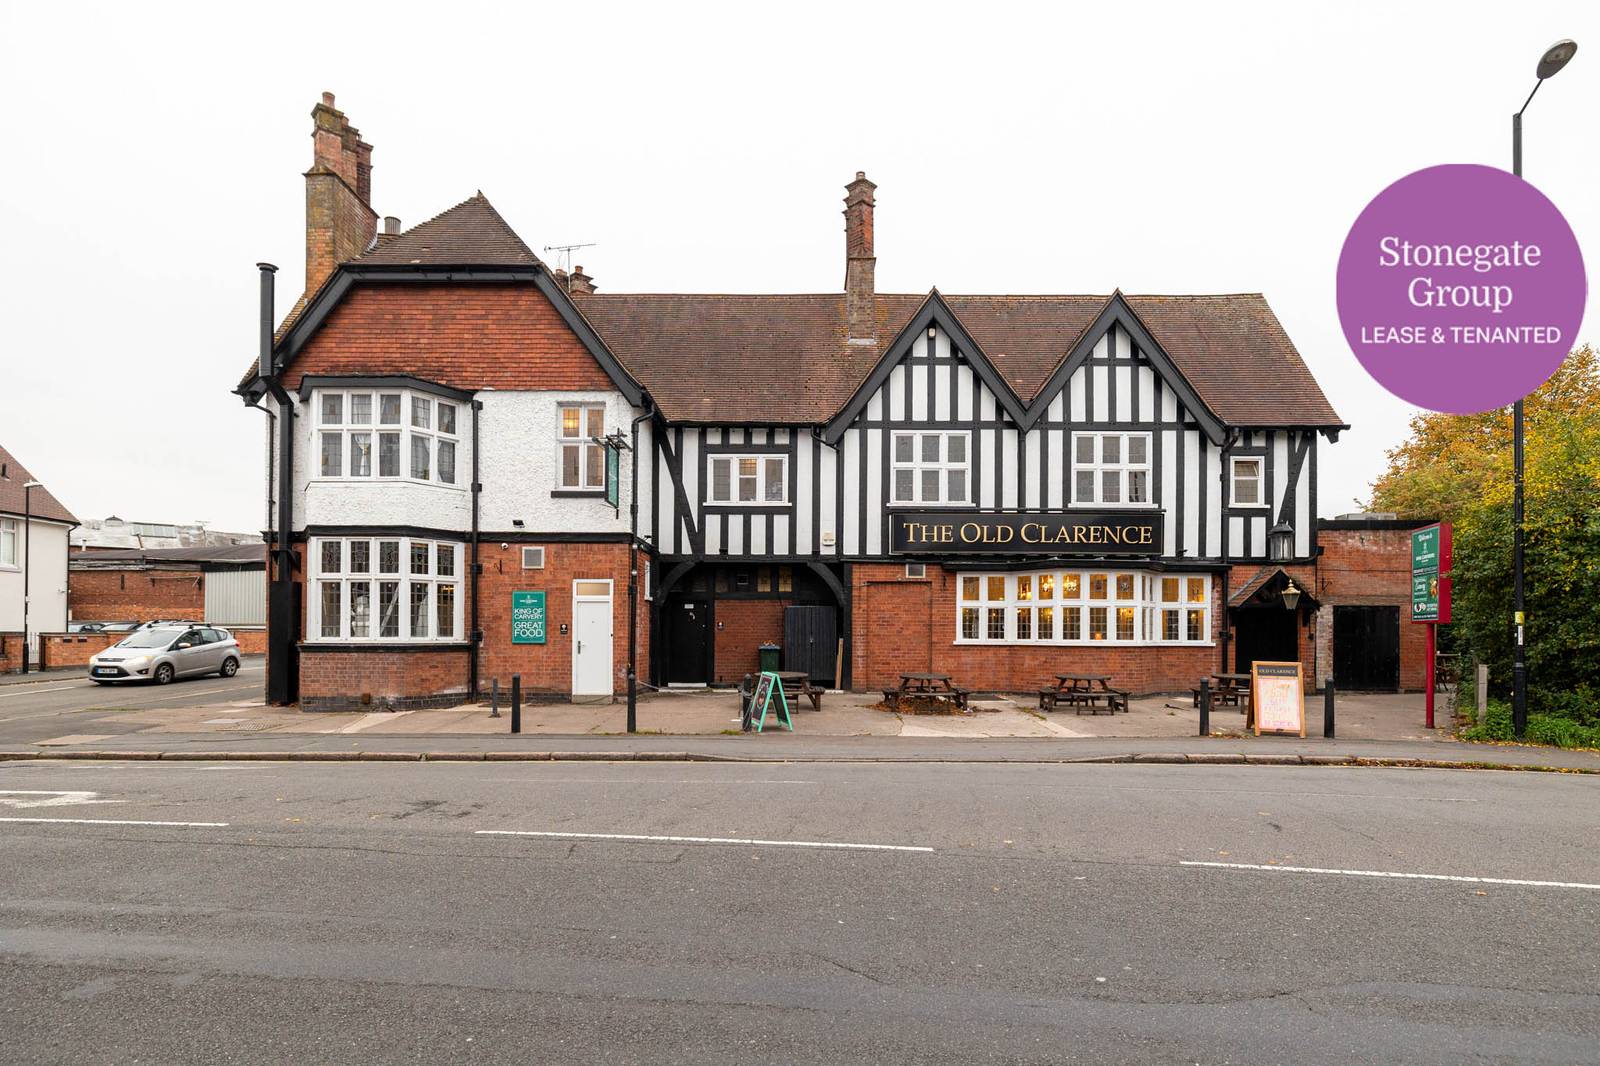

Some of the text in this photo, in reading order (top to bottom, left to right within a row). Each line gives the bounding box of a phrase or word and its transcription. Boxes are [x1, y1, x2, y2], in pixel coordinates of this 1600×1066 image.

[904, 523, 1153, 544] THE OLD CLARENCE
[514, 629, 543, 637] FOOD
